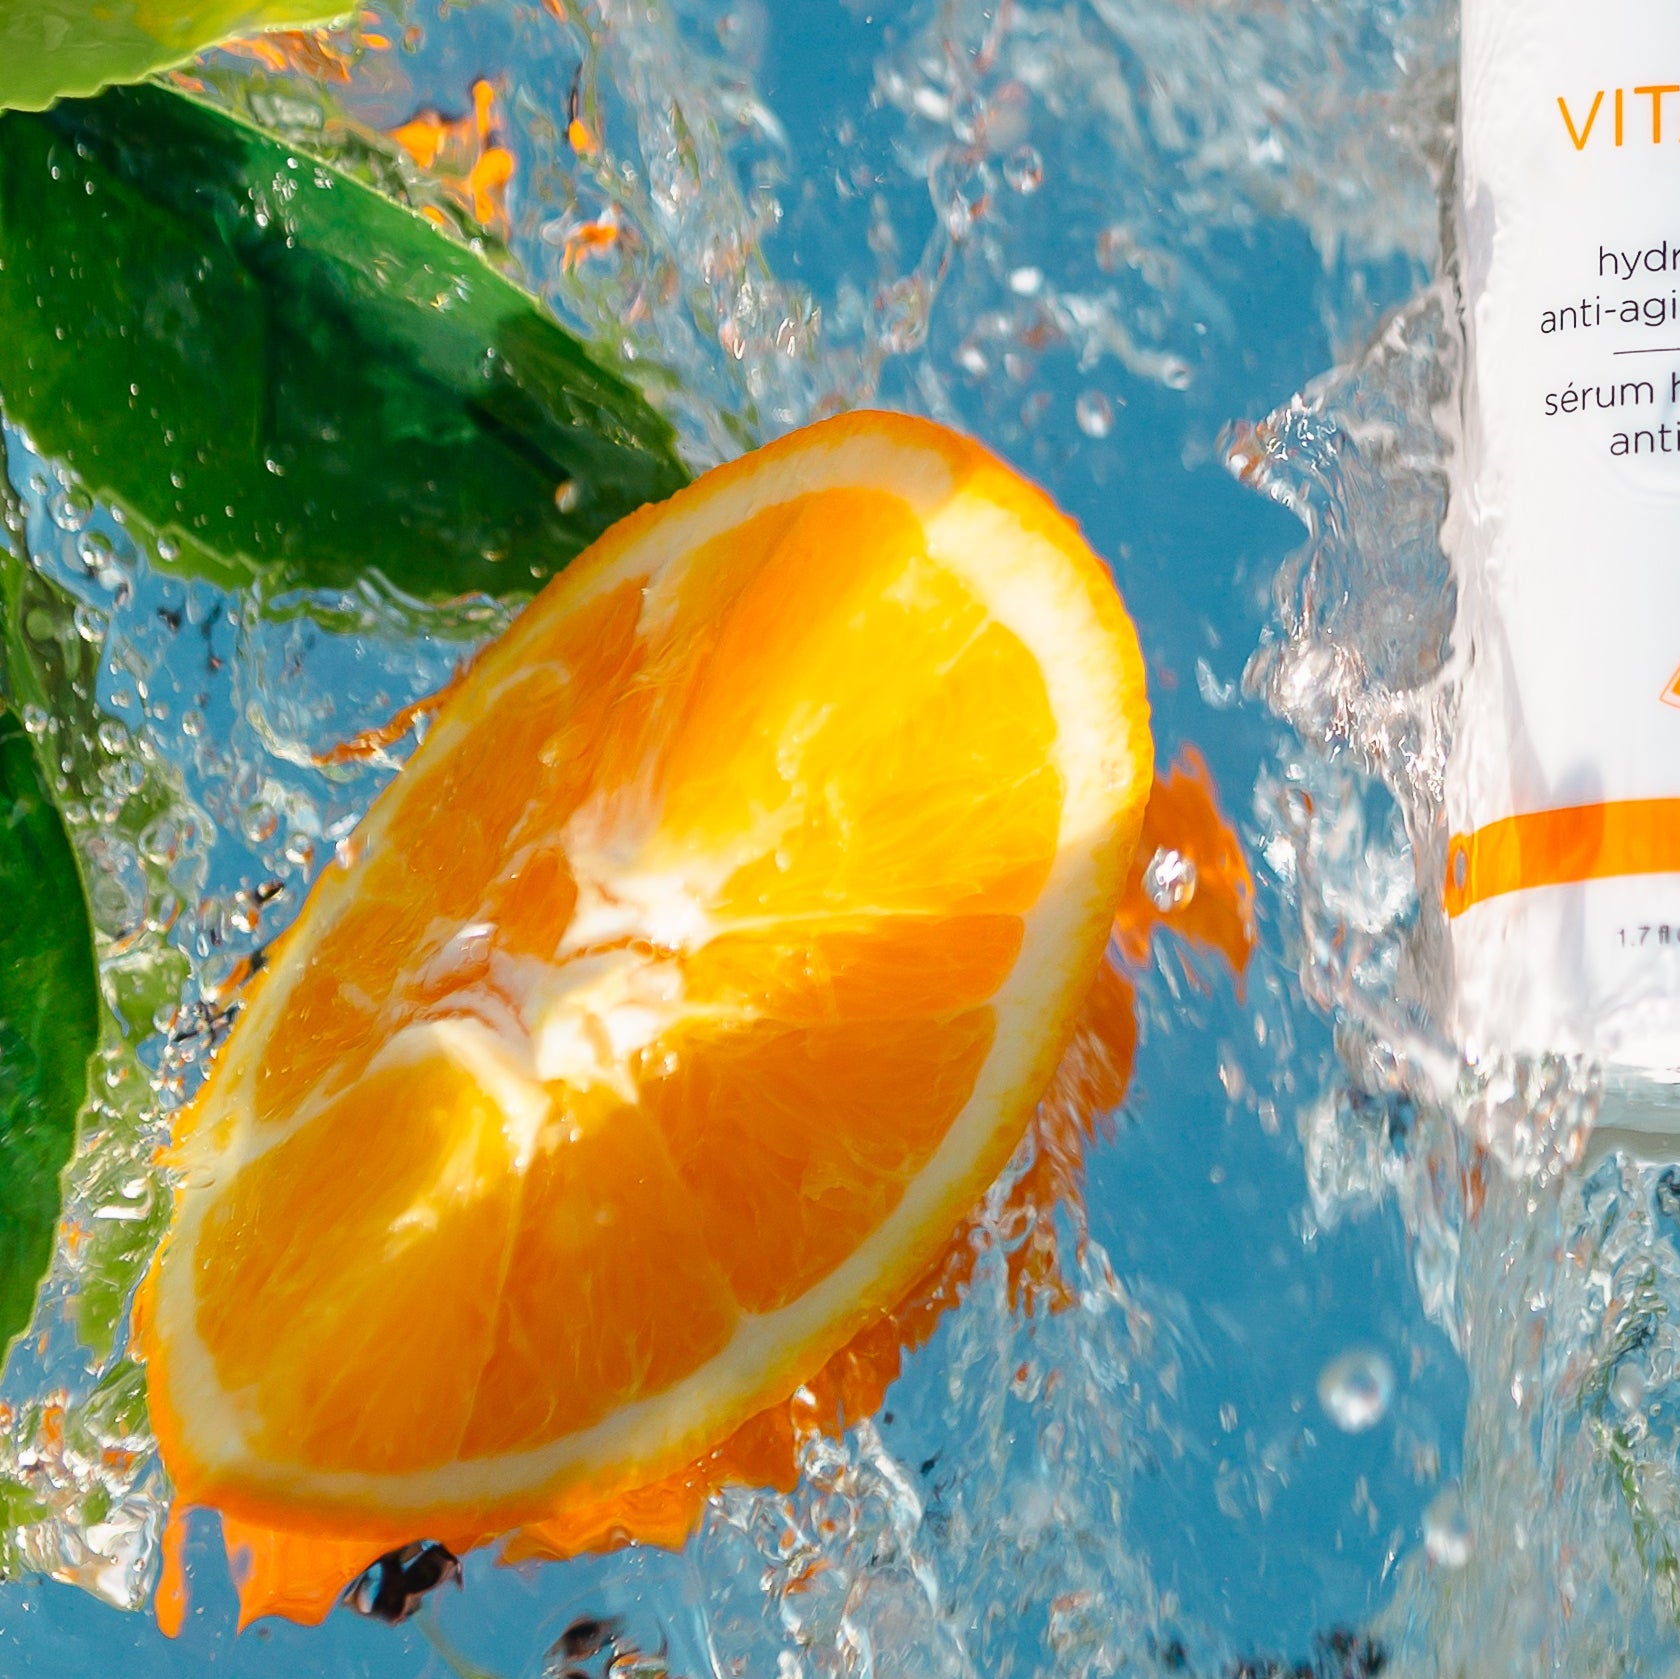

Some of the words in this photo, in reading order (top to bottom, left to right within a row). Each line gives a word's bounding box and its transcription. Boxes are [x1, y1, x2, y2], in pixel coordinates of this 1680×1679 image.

[1544, 382, 1654, 416] sérum
[1617, 926, 1651, 947] 1.7
[1658, 925, 1671, 944] fl
